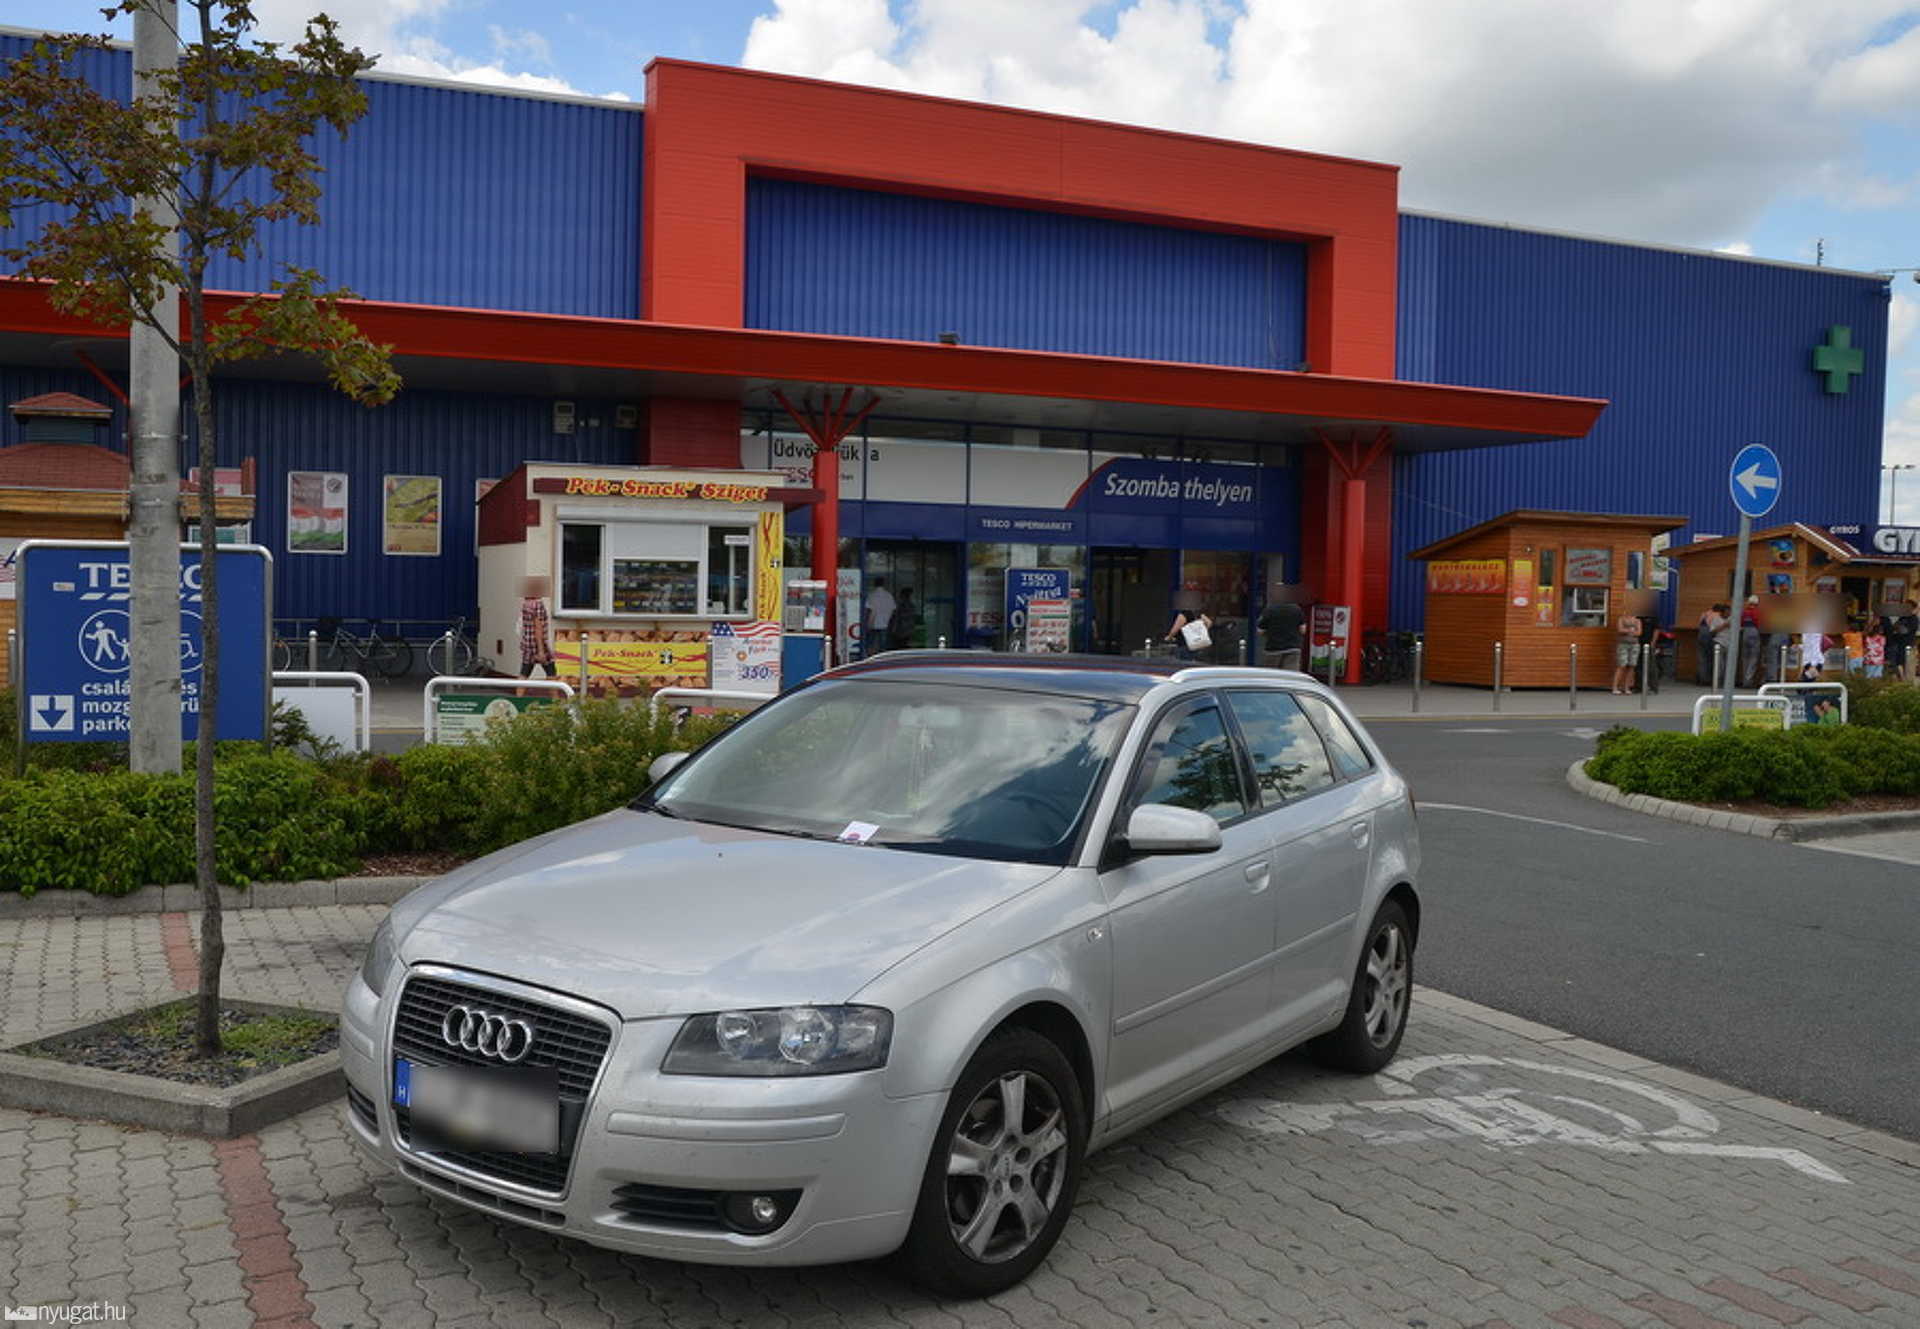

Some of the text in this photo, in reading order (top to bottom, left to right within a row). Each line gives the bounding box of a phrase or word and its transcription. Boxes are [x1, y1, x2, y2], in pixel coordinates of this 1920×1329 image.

[774, 438, 861, 462] Üdvöük
[701, 483, 766, 503] Sziget
[1104, 472, 1253, 507] Szomba thelyen
[82, 680, 132, 695] csalá
